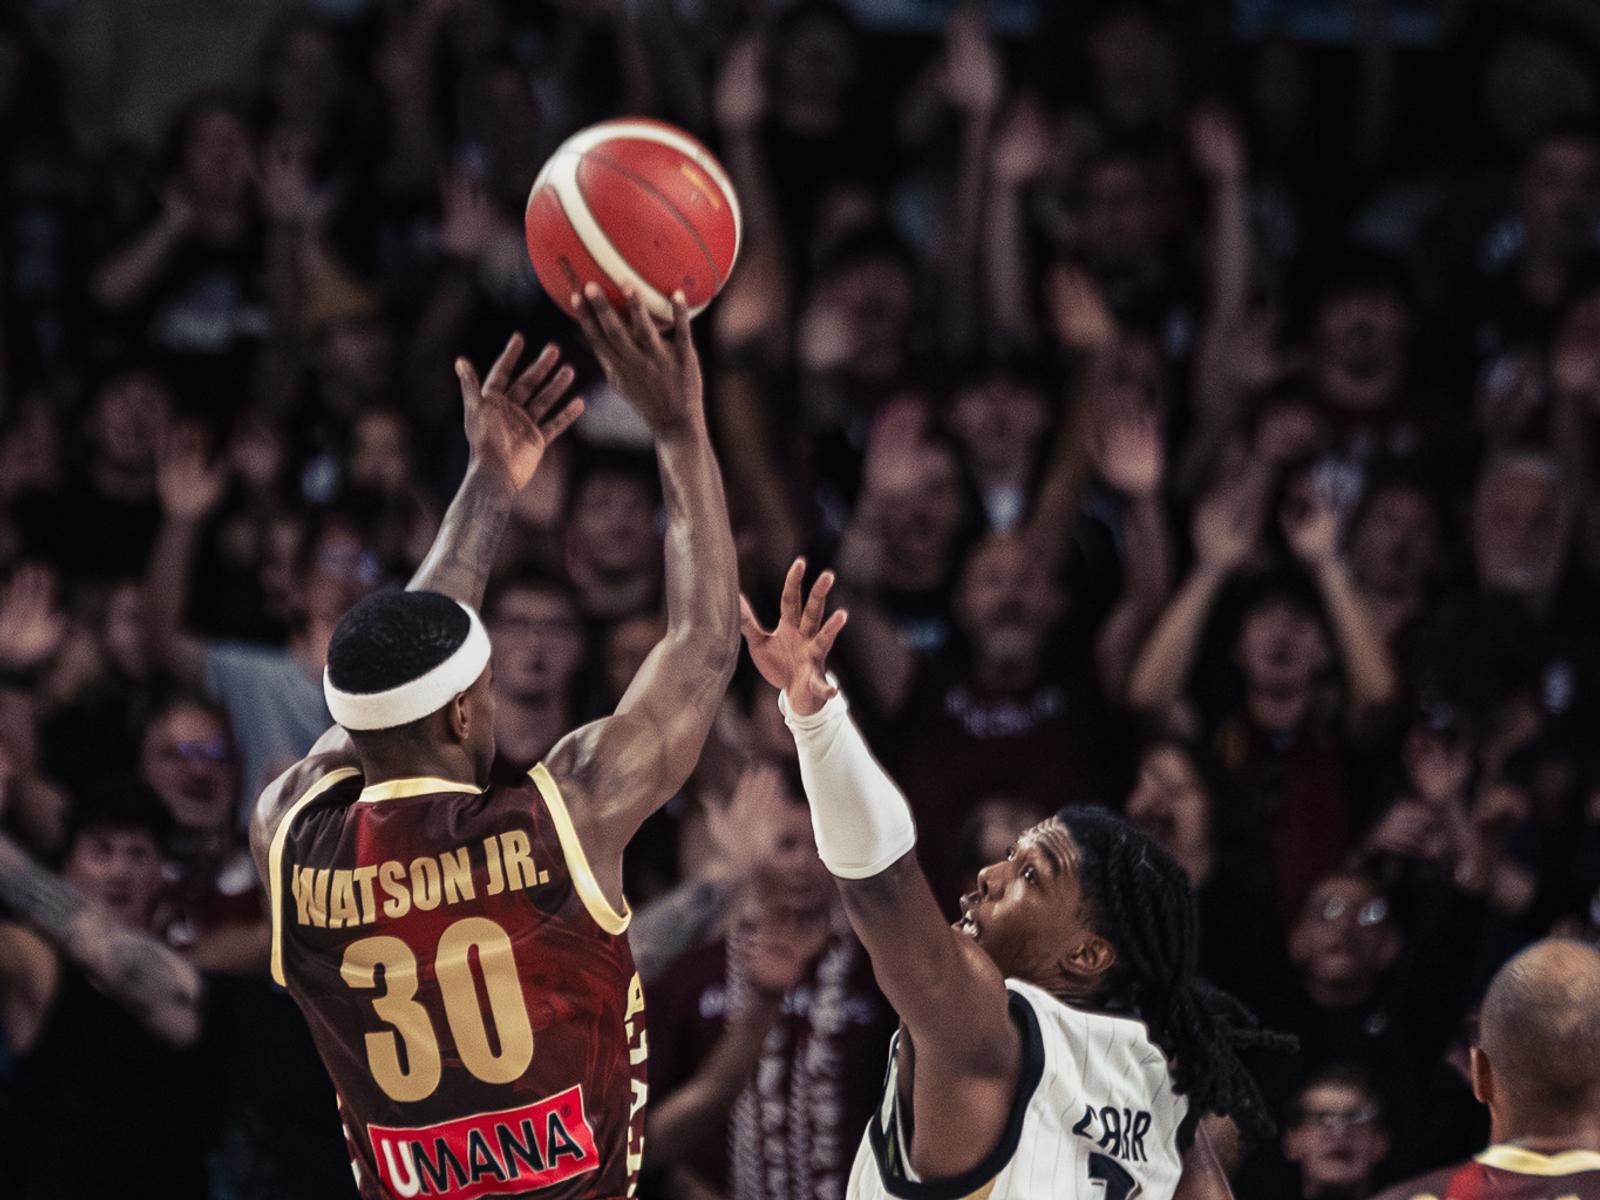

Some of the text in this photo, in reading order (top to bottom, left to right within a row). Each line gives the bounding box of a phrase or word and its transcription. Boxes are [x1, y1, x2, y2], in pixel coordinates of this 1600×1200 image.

[291, 829, 550, 929] WATSON JR.
[339, 916, 534, 1103] 30
[381, 1110, 585, 1199] UMANA
